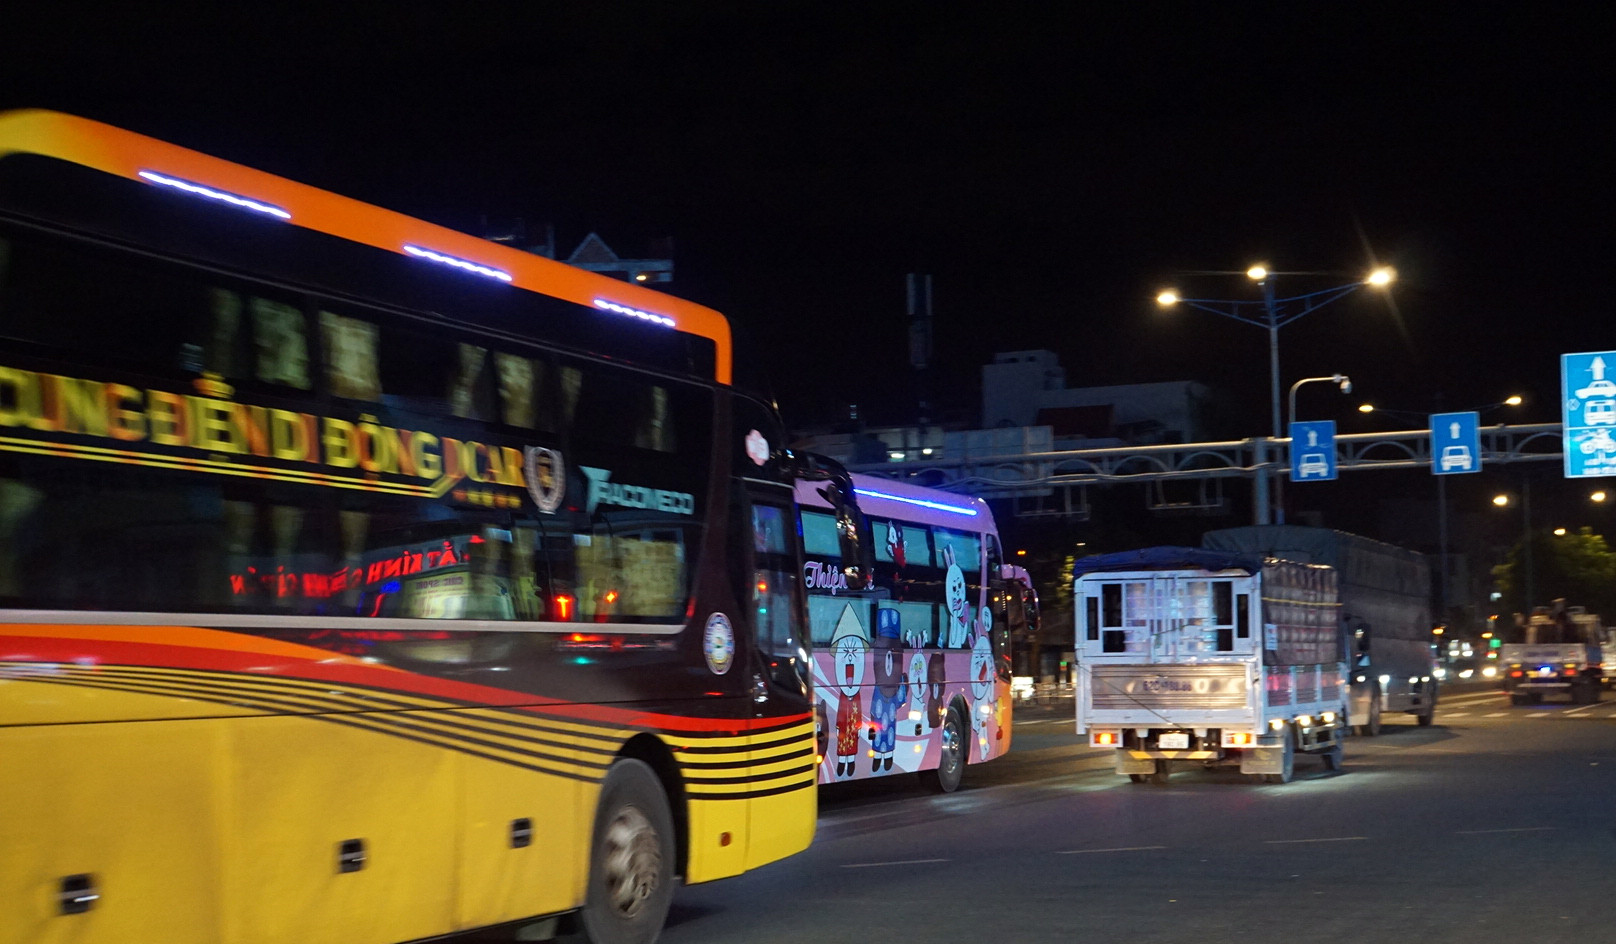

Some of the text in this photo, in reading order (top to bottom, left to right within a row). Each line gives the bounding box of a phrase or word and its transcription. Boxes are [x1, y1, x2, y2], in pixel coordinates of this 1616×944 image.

[269, 407, 320, 464] DI
[322, 413, 443, 481] ĐỘNG
[578, 465, 694, 516] TRACOMECO
[803, 560, 848, 595] Thiện
